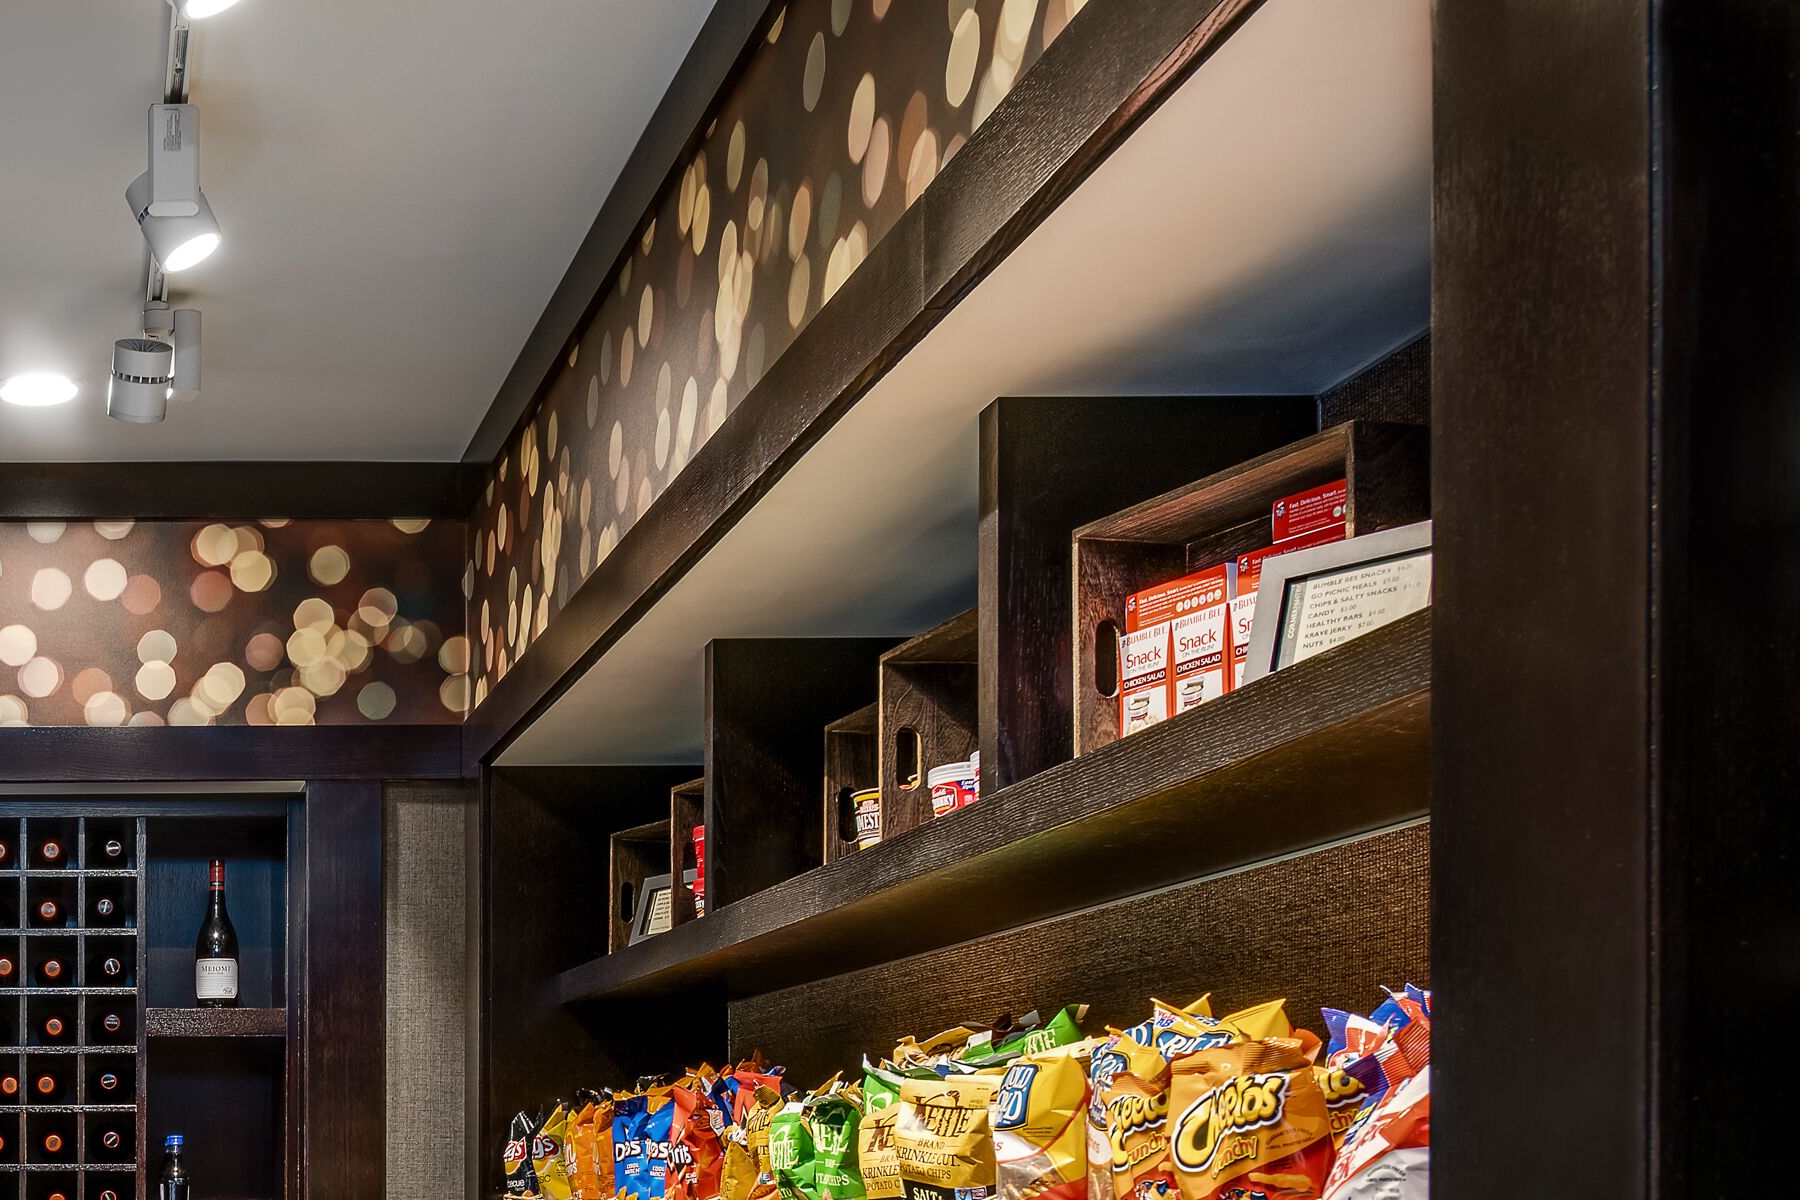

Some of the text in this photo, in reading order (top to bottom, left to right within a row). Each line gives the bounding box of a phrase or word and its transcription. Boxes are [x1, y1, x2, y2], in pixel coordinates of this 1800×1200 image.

[1313, 579, 1343, 590] BUMBLE
[1361, 567, 1392, 579] SNACKS
[1310, 600, 1332, 609] CHIPS
[1340, 593, 1365, 603] SALTY
[1367, 586, 1398, 597] SNACKS
[1311, 581, 1377, 599] GO PICNIC MEALS
[1306, 616, 1343, 629] HEALTHY
[1344, 612, 1363, 622] BARS
[1308, 609, 1335, 619] CANDY
[1180, 629, 1216, 652] Snack
[1304, 630, 1329, 639] KRAVE
[1329, 624, 1353, 635] JERKY
[1303, 640, 1324, 649] NUTS
[1126, 646, 1162, 668] Snack
[1177, 654, 1221, 672] CHICKEN SALAD
[1124, 671, 1165, 689] CHICKEN SALAD
[1176, 1076, 1287, 1168] Cheetos
[918, 1140, 945, 1150] BRAND
[927, 1167, 952, 1180] CHIPS
[866, 1180, 892, 1191] POTATO
